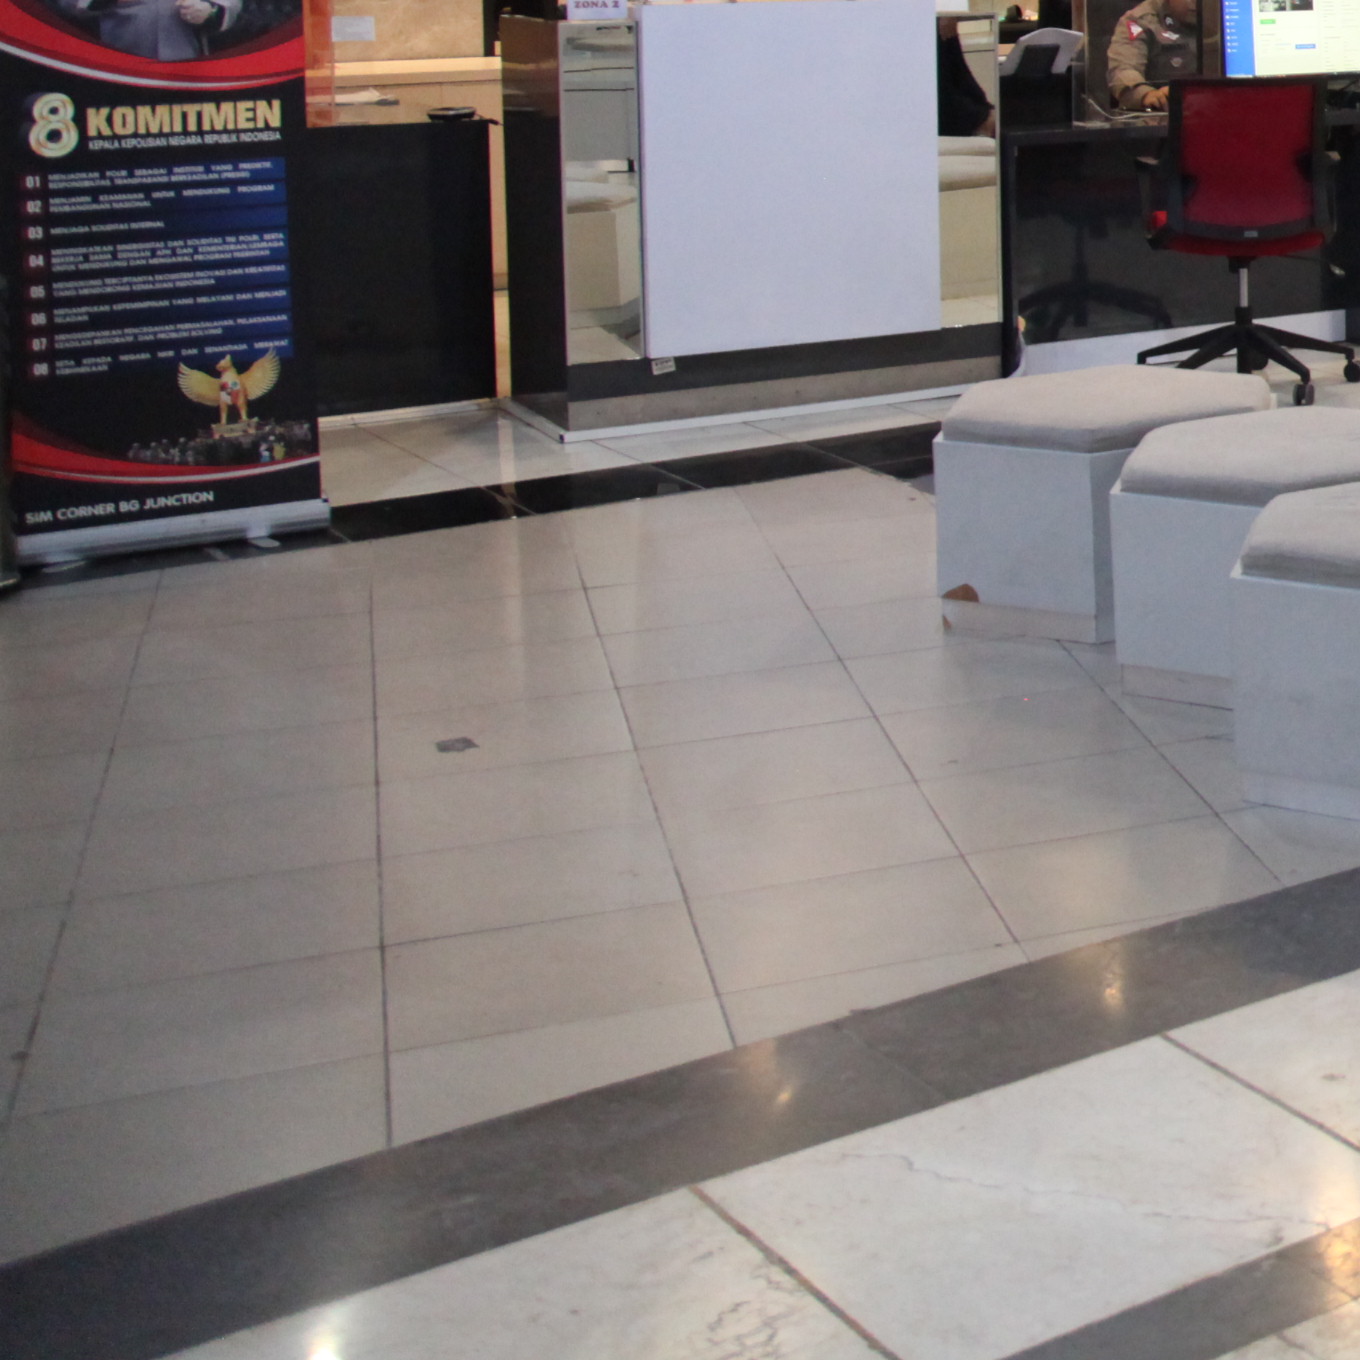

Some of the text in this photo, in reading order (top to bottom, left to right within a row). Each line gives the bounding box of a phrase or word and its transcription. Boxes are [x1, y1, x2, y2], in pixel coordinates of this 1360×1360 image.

[574, 0, 619, 9] ZONA 2
[28, 92, 281, 157] 8 KOMITMEN
[88, 139, 119, 150] KEPALA
[169, 135, 202, 146] NEGARA
[239, 131, 281, 142] INDONESIA
[25, 176, 40, 187] 01
[27, 201, 42, 212] 02
[28, 227, 43, 239] 03
[29, 255, 44, 267] 04
[30, 285, 45, 298] 05
[33, 338, 47, 350] 07
[57, 503, 116, 520] CORNER
[118, 500, 139, 512] BG
[143, 491, 214, 510] JUNCTION
